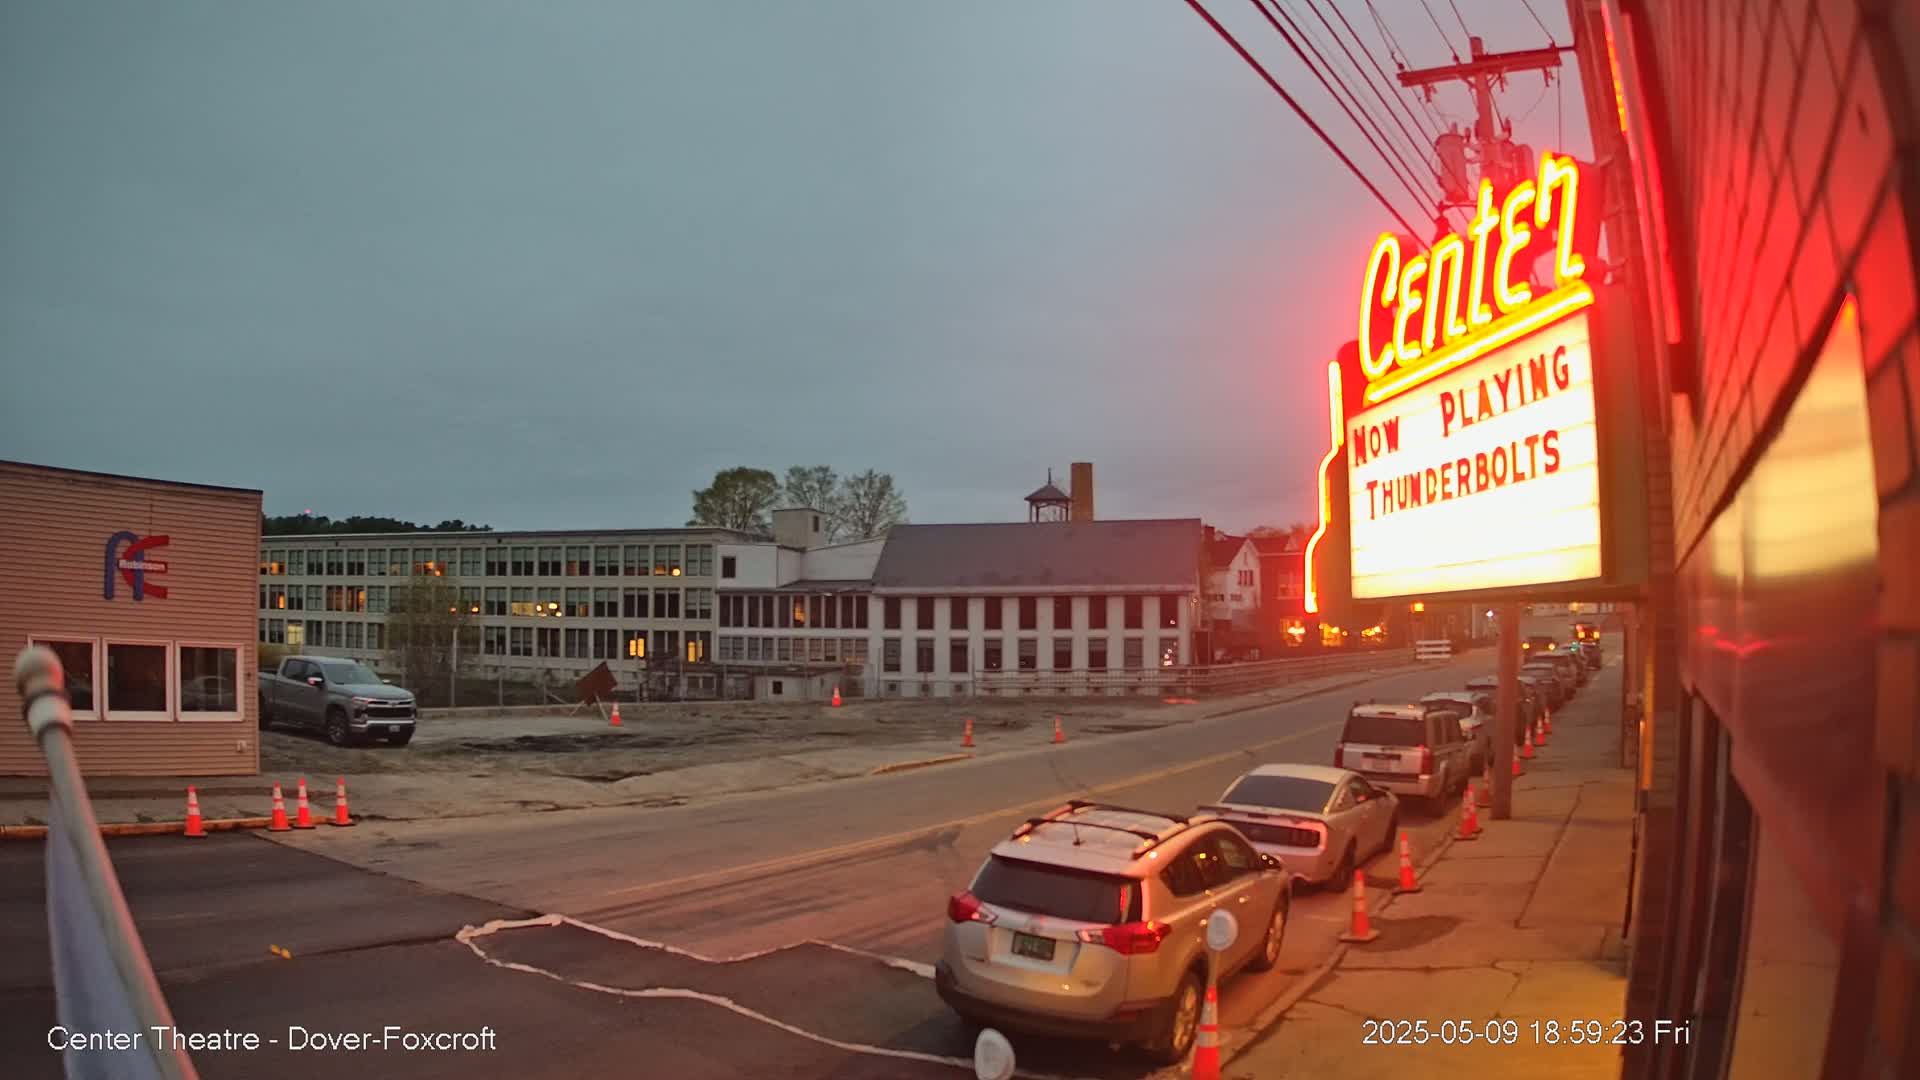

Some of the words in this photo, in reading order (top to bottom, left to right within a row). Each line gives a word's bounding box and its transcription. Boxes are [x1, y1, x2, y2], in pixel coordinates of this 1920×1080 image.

[1354, 416, 1399, 467] NOW
[1440, 345, 1569, 437] PLAYING
[1366, 430, 1560, 520] THUNDERBOLTS
